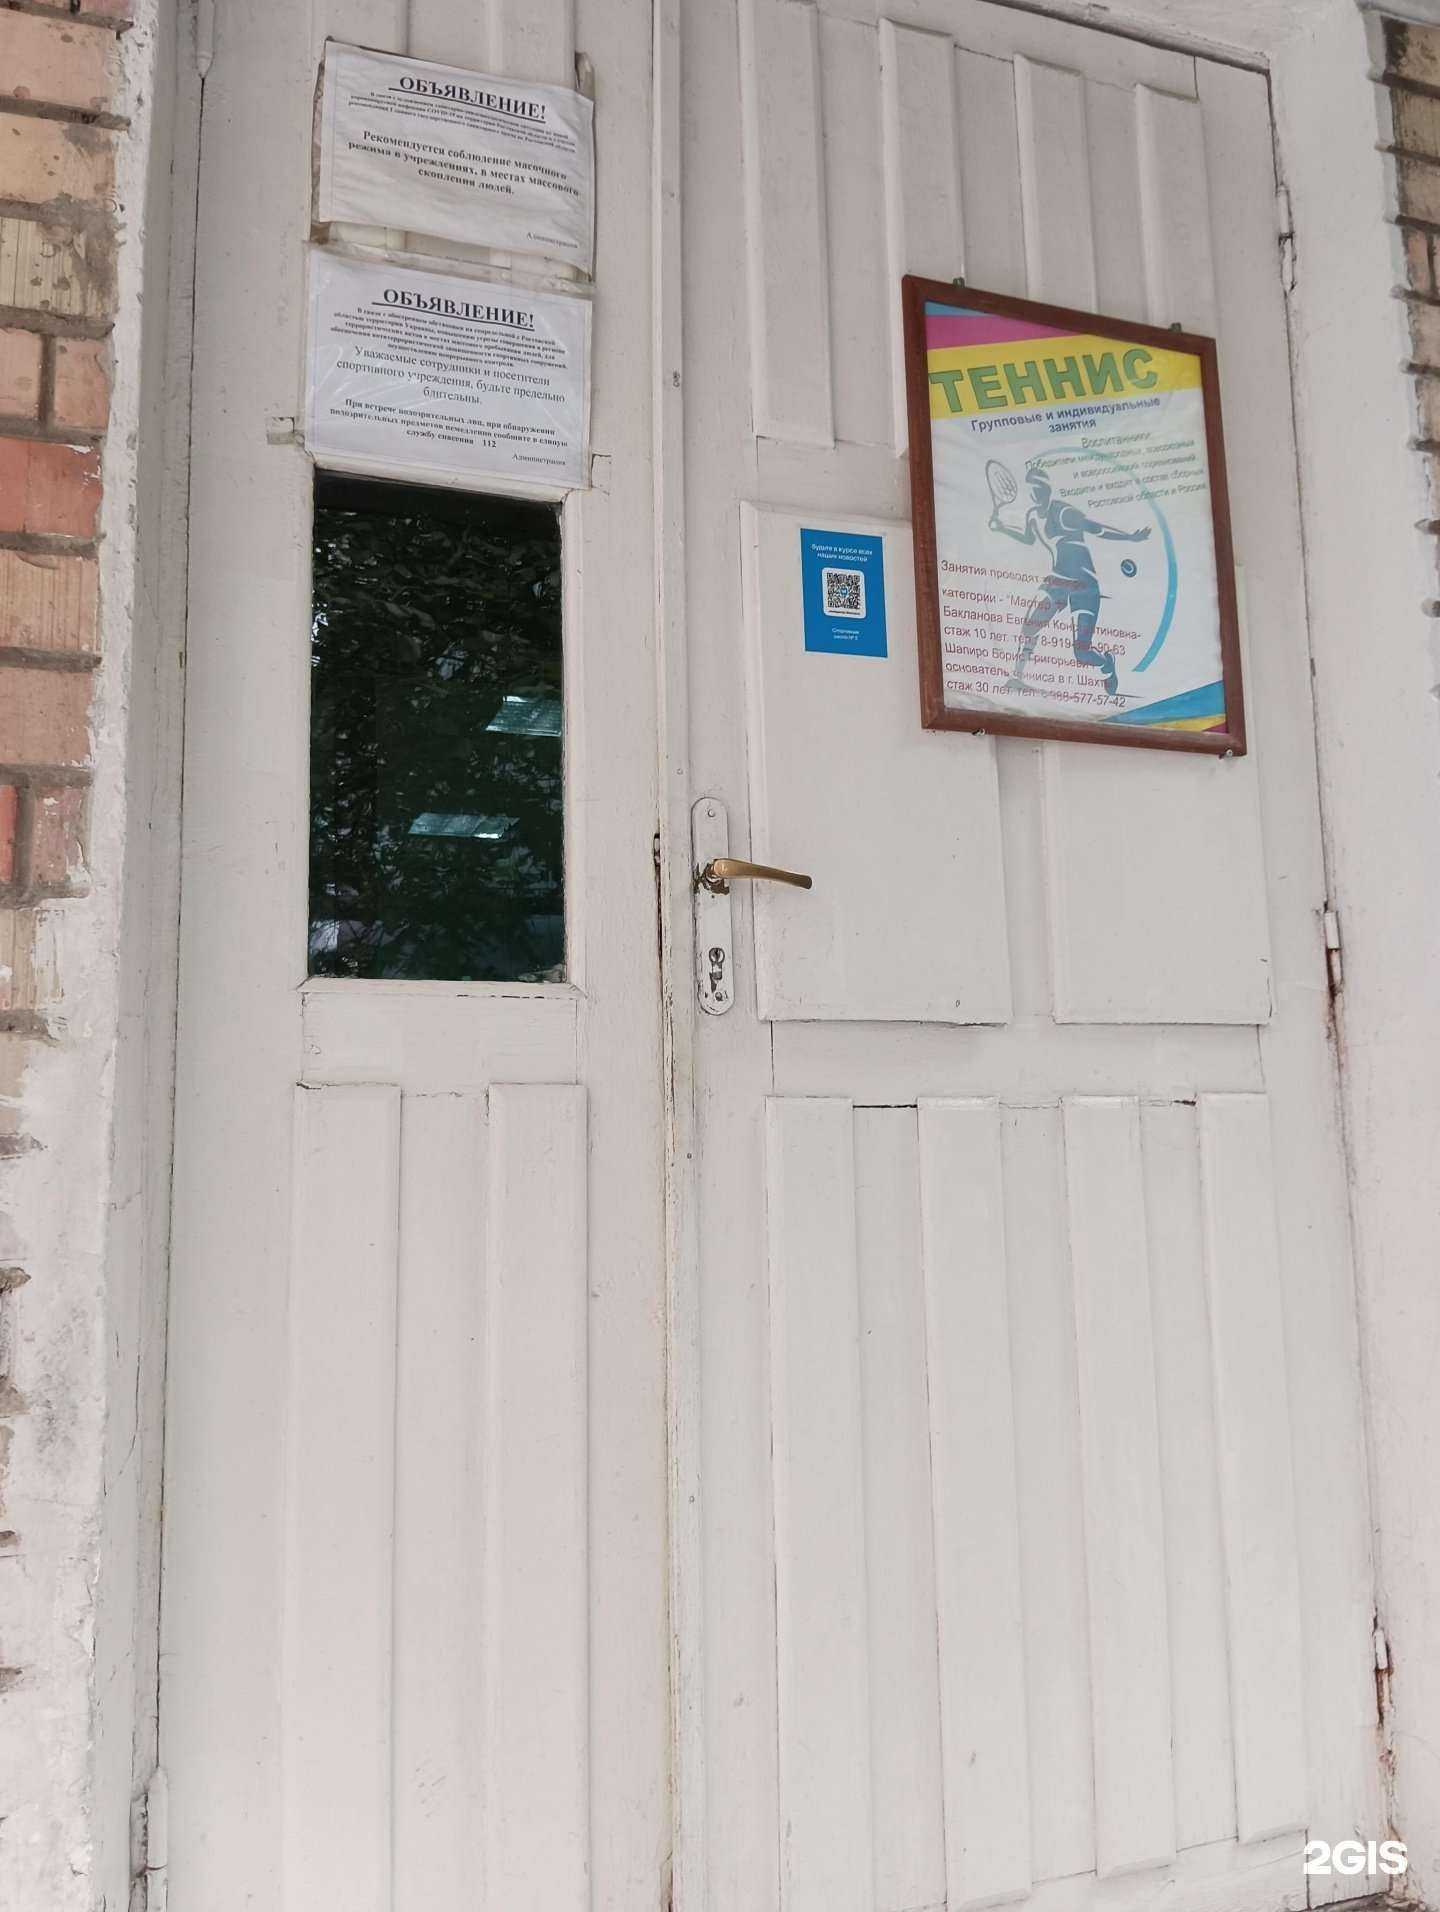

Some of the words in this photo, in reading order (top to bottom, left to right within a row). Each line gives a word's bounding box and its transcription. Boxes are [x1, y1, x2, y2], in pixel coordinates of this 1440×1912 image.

[400, 77, 546, 120] ОБЪЯВЛЕНИЕ!
[363, 130, 445, 156] Рекомендуется
[447, 149, 511, 167] соблюдение
[514, 160, 567, 180] масочного
[348, 141, 391, 157] режима
[481, 168, 487, 177] в
[490, 170, 526, 184] местах
[529, 176, 579, 198] массового
[418, 168, 476, 187] скопления
[384, 288, 534, 328] ОБЪЯВЛЕНИЕ!
[355, 345, 417, 365] Уважаемые
[419, 358, 481, 375] сотрудники
[483, 369, 490, 377] и
[493, 370, 550, 386] посетители
[336, 360, 405, 378] спортивного
[476, 379, 511, 394] будьте
[513, 387, 566, 403] предельно
[928, 348, 1159, 413] ТЕННИС
[330, 408, 398, 424] подозрительных
[400, 418, 444, 430] предметов
[345, 398, 363, 409] При
[365, 402, 396, 413] встрече
[398, 408, 465, 424] подозрительных
[486, 420, 502, 431] при
[503, 422, 555, 436] обнаружении
[971, 412, 1043, 433] Групповые
[1046, 411, 1054, 421] и
[1057, 397, 1161, 420] индивидуальные
[1048, 418, 1097, 434] занятия
[406, 429, 435, 440] службу
[437, 433, 474, 445] спасения
[482, 439, 497, 448] 112
[941, 560, 987, 576] Занятия
[990, 569, 1039, 583] проводят
[942, 587, 996, 604] категории
[943, 605, 1003, 623] Бакланова
[944, 626, 971, 638] стаж
[974, 628, 987, 639] 10
[944, 642, 989, 659] Шапиро
[992, 647, 1023, 661] Борис
[945, 662, 1010, 677] основатель
[1058, 676, 1065, 684] в
[946, 679, 973, 691] стаж
[975, 681, 989, 693] 30
